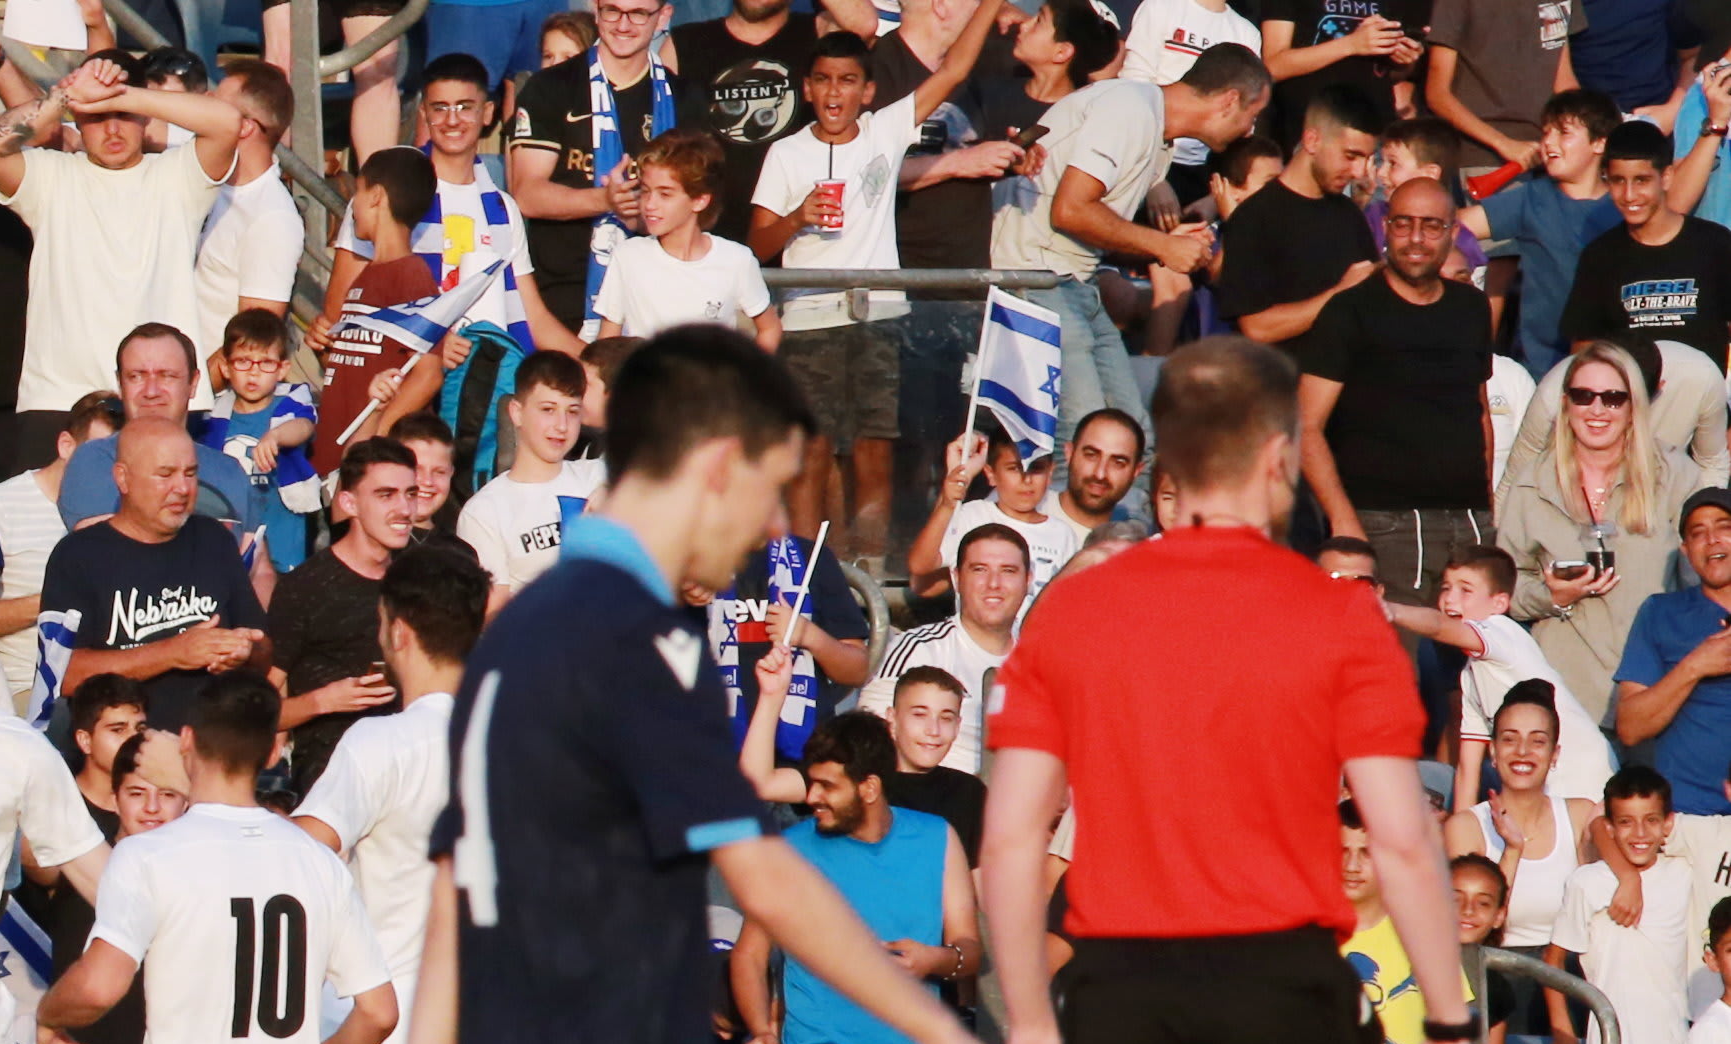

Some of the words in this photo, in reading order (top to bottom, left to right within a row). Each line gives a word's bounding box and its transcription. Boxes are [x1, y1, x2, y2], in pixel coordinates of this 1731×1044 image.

[714, 86, 771, 101] LISTEN
[1621, 278, 1699, 301] DIESEL
[106, 586, 218, 646] Nebraska
[229, 894, 307, 1040] 10
